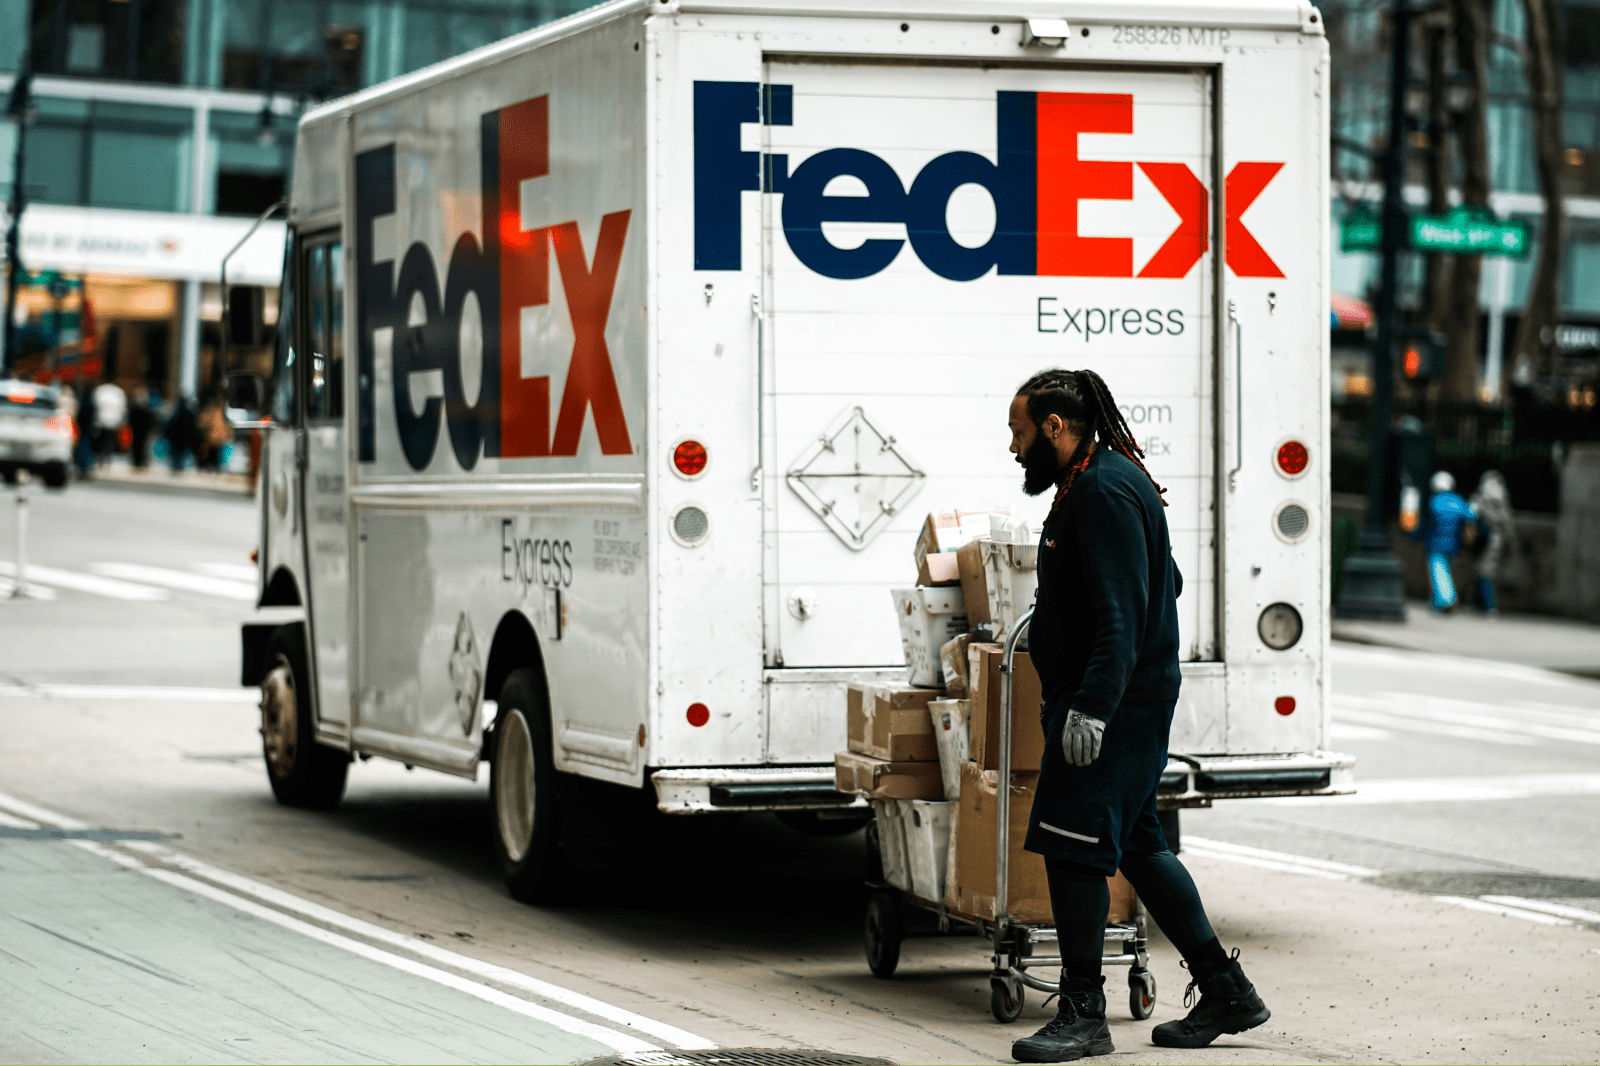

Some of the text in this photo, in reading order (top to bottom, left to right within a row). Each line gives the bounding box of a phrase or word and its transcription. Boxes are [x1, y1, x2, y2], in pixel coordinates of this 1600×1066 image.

[1112, 26, 1231, 46] 258326 MTP
[693, 81, 1287, 282] FedEx
[354, 93, 634, 473] FedEx
[1038, 297, 1185, 342] Express
[502, 518, 573, 599] Express
